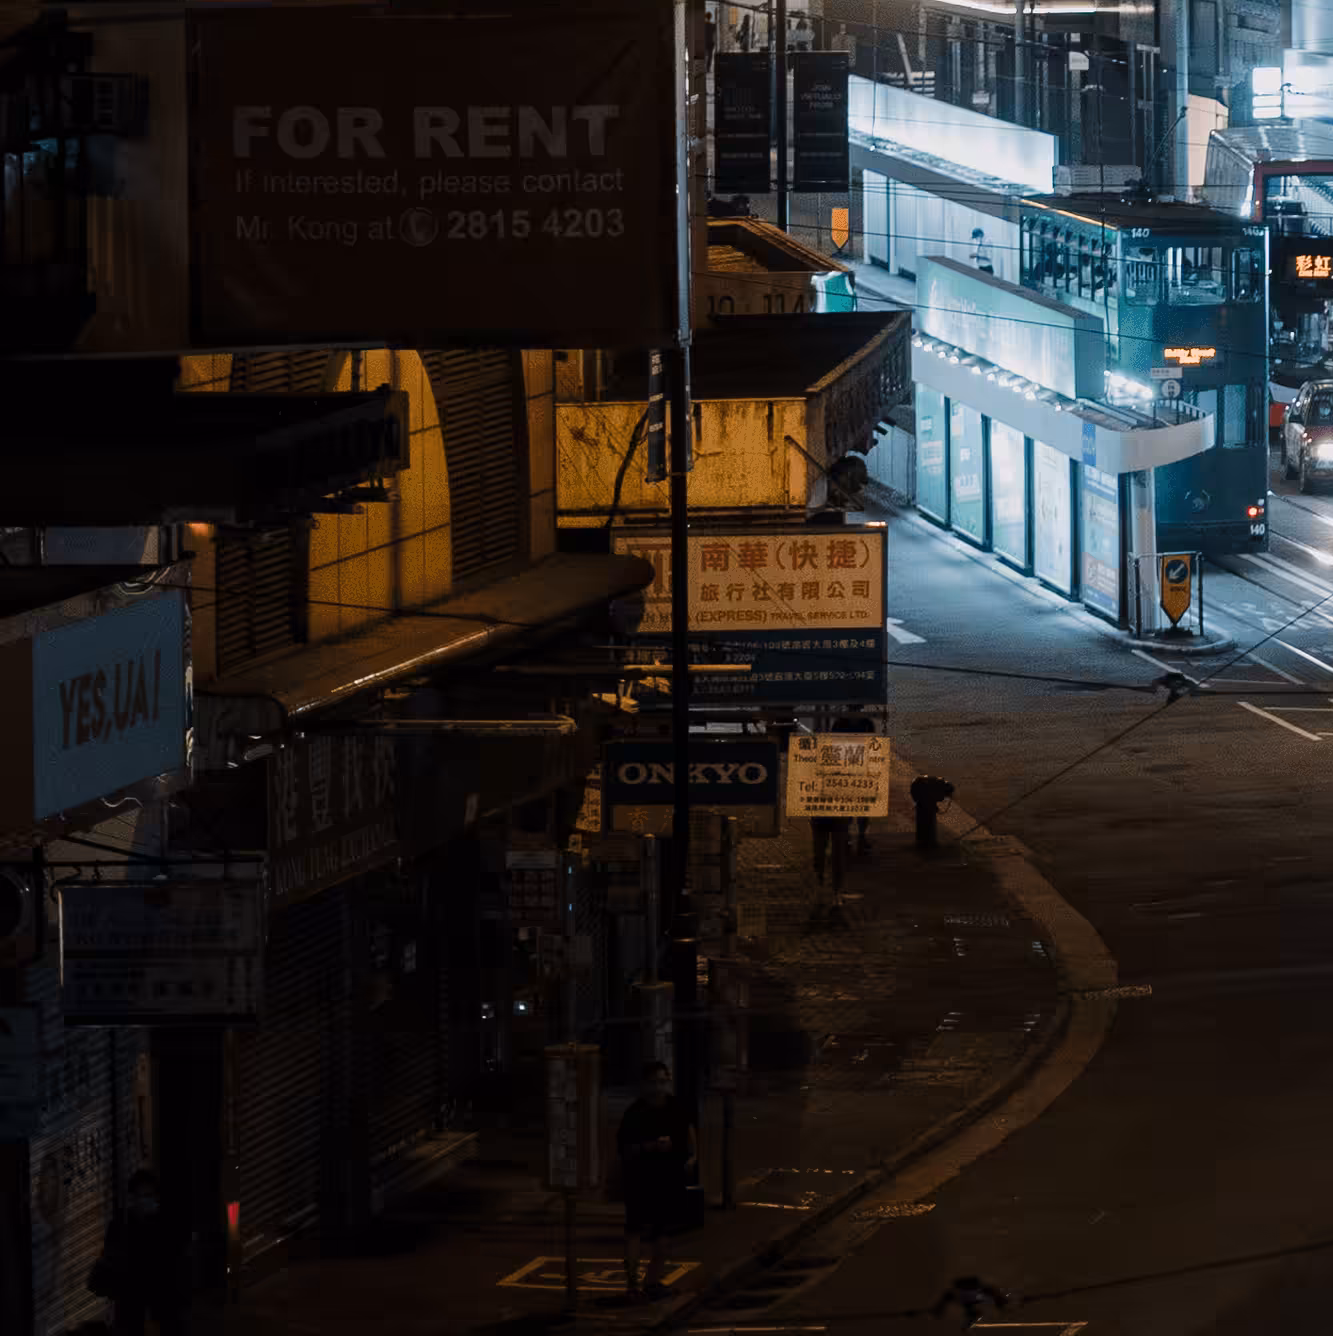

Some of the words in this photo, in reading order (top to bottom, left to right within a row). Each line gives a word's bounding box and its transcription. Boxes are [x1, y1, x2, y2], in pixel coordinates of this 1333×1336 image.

[232, 104, 387, 160] FOR
[412, 104, 620, 160] RENT
[235, 169, 256, 193] If
[263, 168, 407, 198] interested,
[420, 169, 512, 200] please
[521, 168, 624, 193] contact
[287, 216, 359, 248] Kong
[367, 216, 393, 241] at
[447, 209, 531, 241] 2815
[542, 207, 625, 239] 4203
[1131, 227, 1150, 238] 140
[1250, 523, 1265, 536] 140
[694, 610, 768, 625] (EXPRESS)
[617, 762, 769, 785] ONKYO
